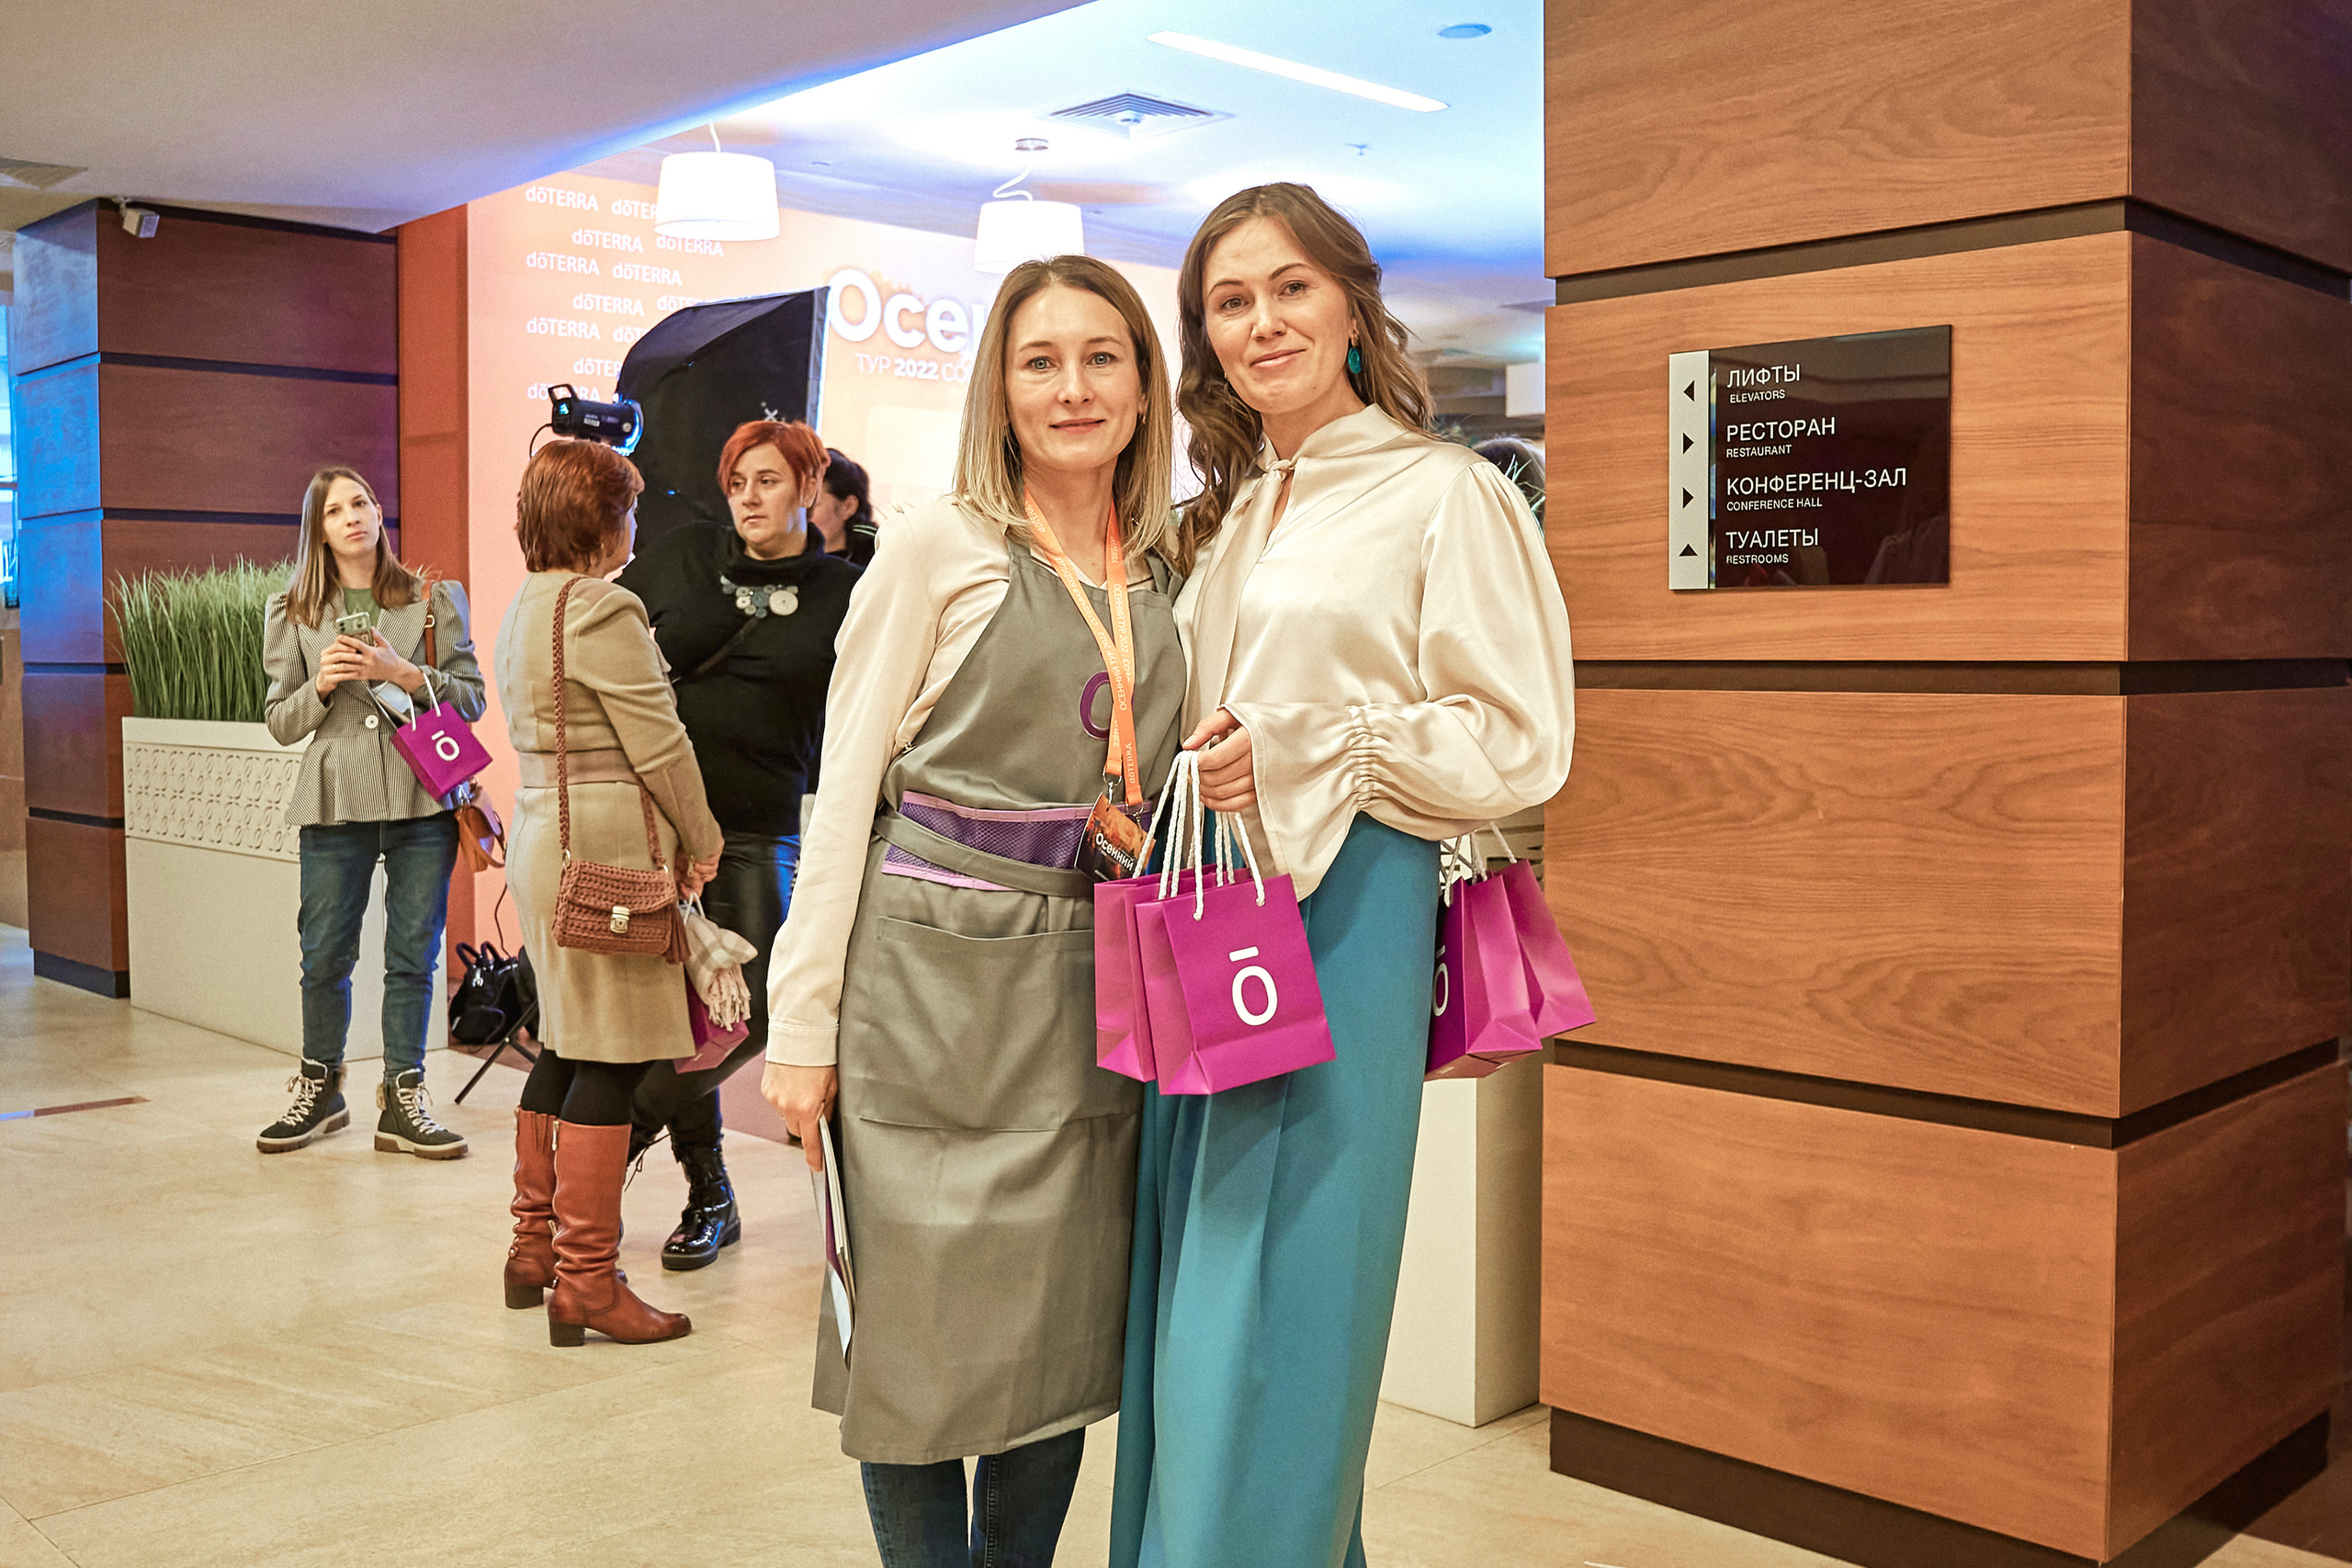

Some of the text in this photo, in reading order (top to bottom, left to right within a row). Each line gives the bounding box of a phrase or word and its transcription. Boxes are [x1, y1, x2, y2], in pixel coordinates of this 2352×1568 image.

[526, 186, 658, 220] dōTERRA dōTER
[572, 229, 644, 254] dōTERRA
[526, 251, 683, 287] dōTERRA dōTERRA
[572, 293, 645, 317] dōTERRA
[526, 317, 601, 340] dōTERRA
[573, 356, 623, 378] dōTER
[894, 357, 939, 380] 2022
[1726, 363, 1801, 389] ЛИФТЫ
[1729, 389, 1786, 404] ELEVATORS
[1726, 417, 1836, 443] РЕСТОРАН
[1725, 445, 1792, 458] RESTAURANT
[1726, 468, 1906, 496] КОНФЕРЕНЦ-ЗАЛ
[1725, 497, 1823, 512] CONFERENCE HALL
[1725, 528, 1819, 549] ТУАЛЕТЫ
[1725, 553, 1789, 565] RESTROOMS
[1098, 631, 1112, 650] 2022
[1119, 634, 1129, 652] 2022
[1096, 832, 1135, 871] Осенний
